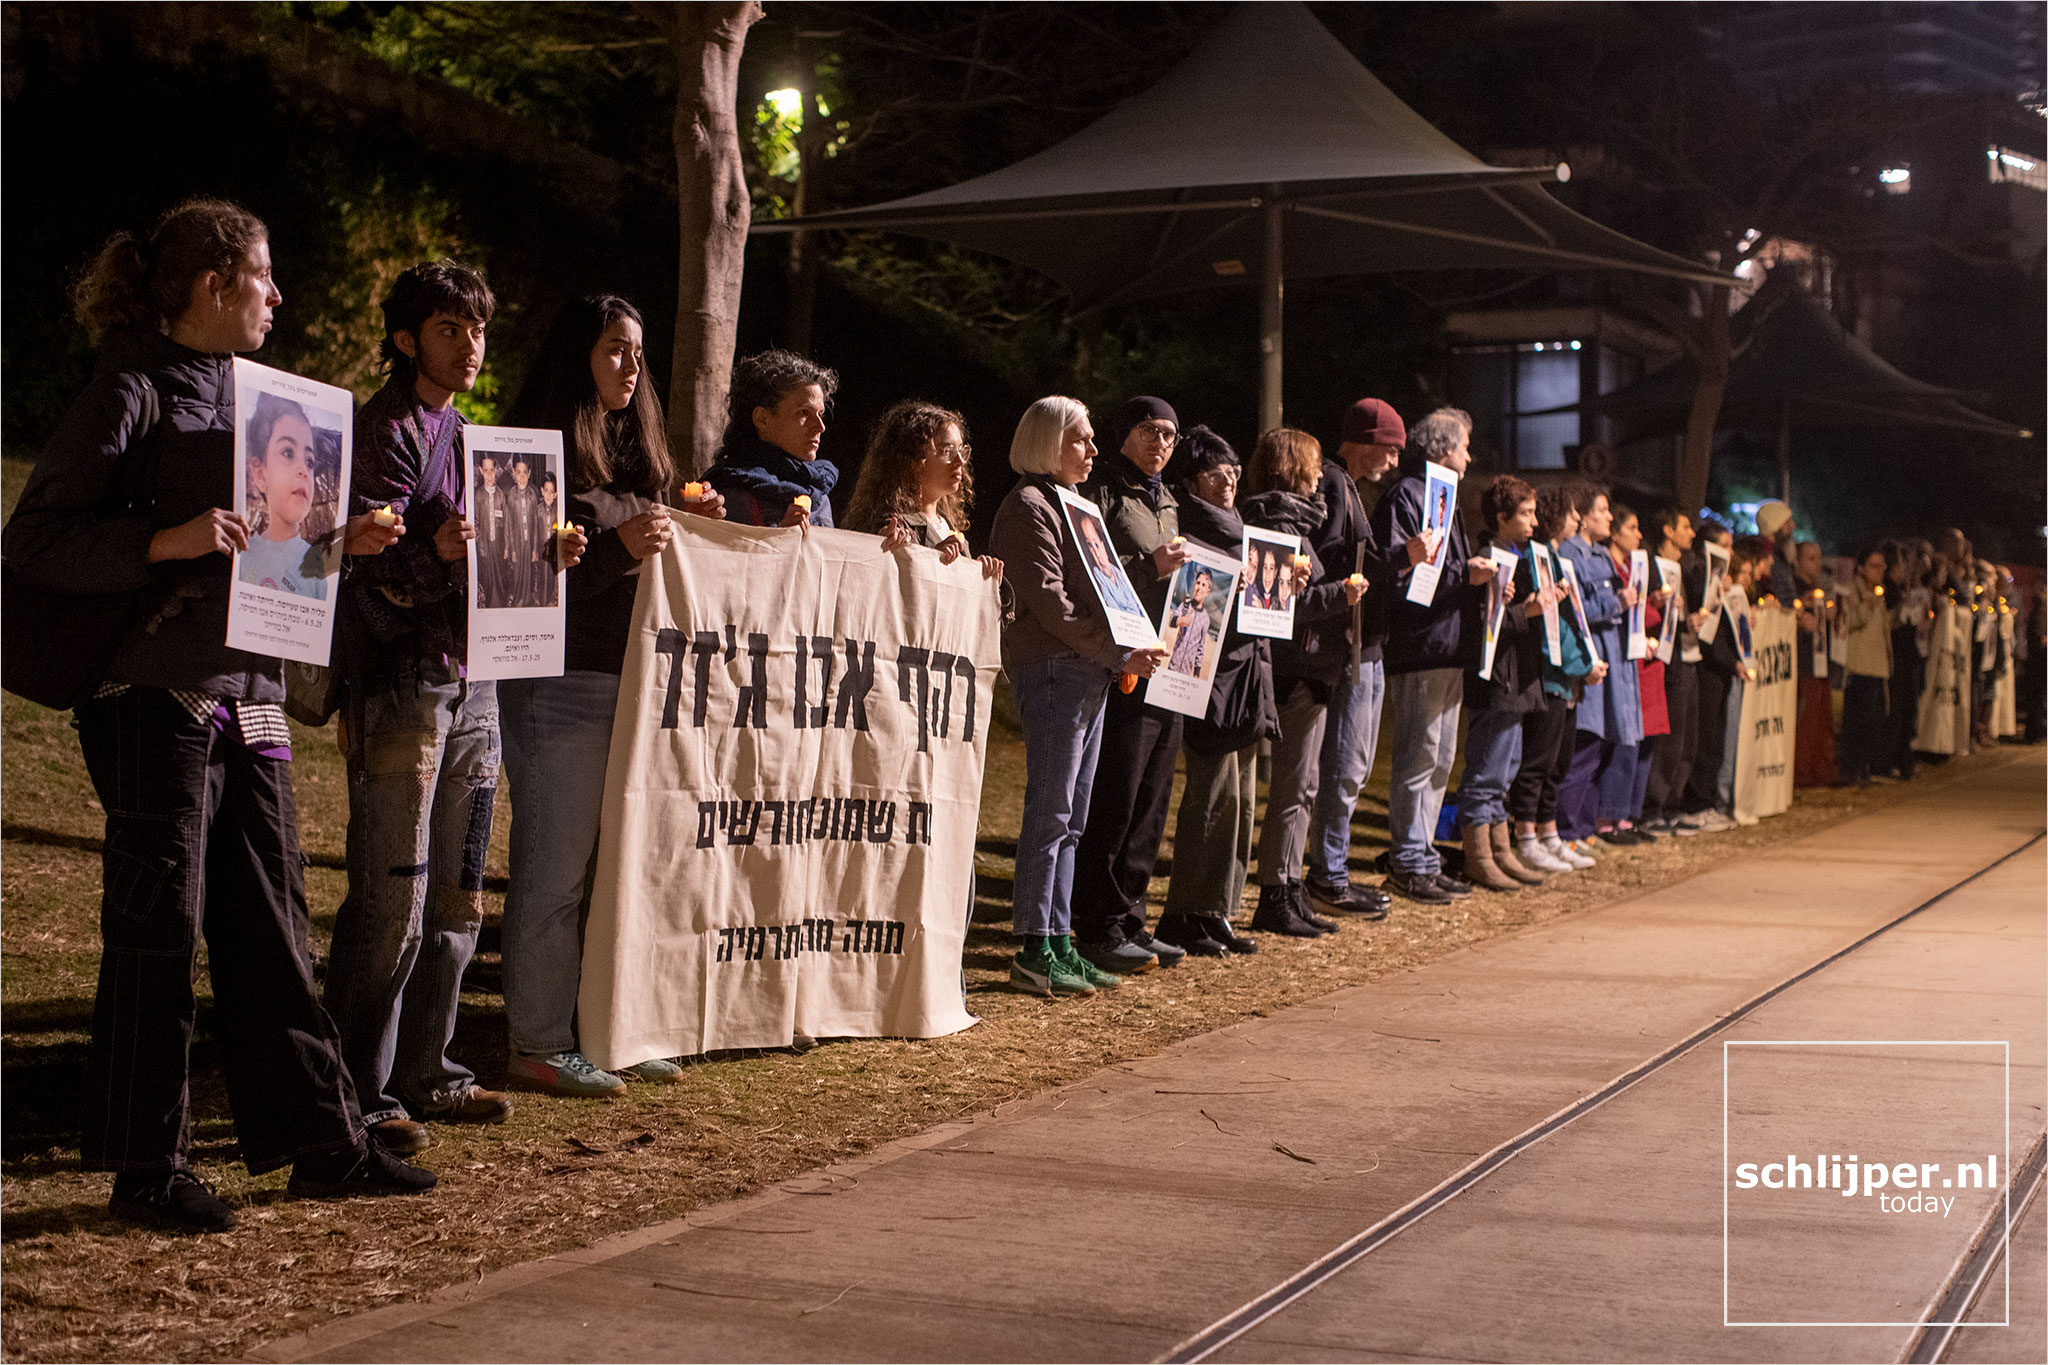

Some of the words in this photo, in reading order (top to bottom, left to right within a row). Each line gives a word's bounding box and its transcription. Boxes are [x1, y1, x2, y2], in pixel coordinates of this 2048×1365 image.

[794, 636, 877, 731] אבו
[897, 645, 976, 752] רהף
[906, 802, 932, 846] ת
[842, 919, 905, 954] מתה
